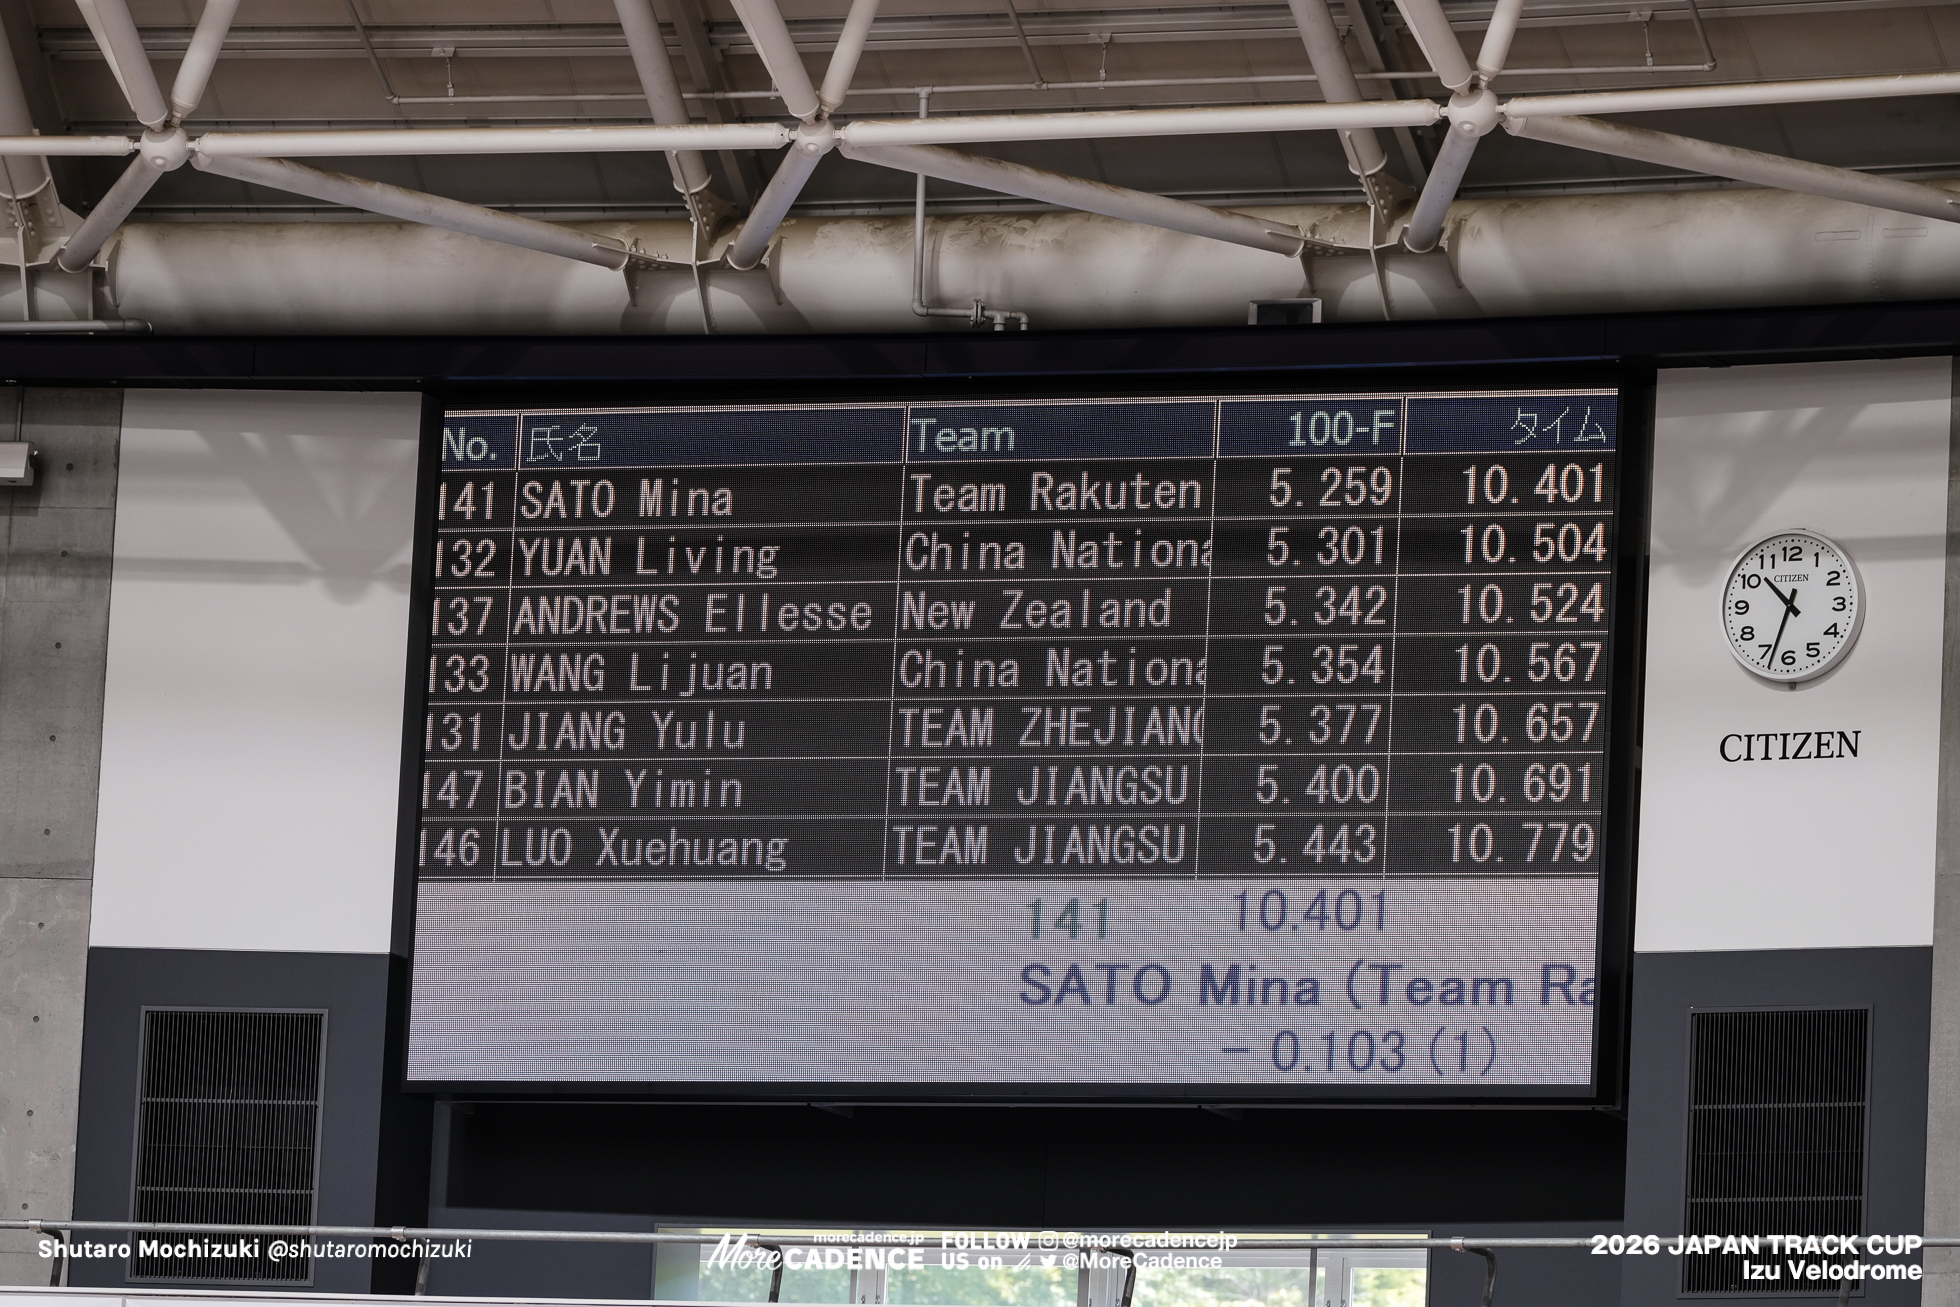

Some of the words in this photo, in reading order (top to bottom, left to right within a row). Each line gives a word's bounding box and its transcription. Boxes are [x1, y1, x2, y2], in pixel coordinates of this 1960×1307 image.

[442, 427, 497, 461] No.
[525, 422, 602, 463] 氏名
[909, 417, 1016, 453] Team
[1288, 409, 1396, 447] 100-F
[1510, 405, 1608, 446] タイム
[438, 481, 494, 521] 141
[520, 479, 616, 520] SATO
[638, 478, 733, 518] Mina
[910, 473, 1006, 513] Team
[1030, 471, 1202, 511] Rakuten
[434, 538, 497, 578] 132
[518, 536, 612, 577] YUAN
[635, 534, 780, 580] Living
[905, 531, 1026, 572] China
[1759, 553, 1776, 569] 11
[1782, 545, 1803, 562] 12
[1813, 551, 1820, 568] 1
[1740, 573, 1761, 590] 10
[1773, 574, 1809, 583] CITIZEN
[1825, 570, 1841, 586] 2
[431, 596, 494, 636] 137
[513, 594, 680, 635] ANDREWS
[704, 592, 873, 633] Ellesse
[901, 590, 976, 630] New
[999, 587, 1172, 630] Zealand
[1734, 600, 1750, 615] 9
[1832, 596, 1847, 612] 3
[1740, 625, 1755, 641] 8
[1805, 642, 1821, 658] 5
[1823, 622, 1840, 638] 4
[899, 648, 1020, 689] China
[1758, 644, 1773, 660] 7
[1781, 650, 1796, 666] 6
[428, 653, 490, 694] 133
[511, 652, 605, 692] WANG
[629, 651, 773, 698] Lijuan
[425, 712, 481, 752] 131
[508, 710, 626, 751] JIANG
[651, 709, 746, 750] Yulu
[898, 707, 994, 748] TEAM
[1719, 731, 1862, 762] CITIZEN
[422, 769, 484, 809] 147
[504, 769, 599, 809] BIAN
[624, 768, 743, 808] Yimin
[895, 766, 991, 807] TEAM
[1016, 765, 1189, 806] JIANGSU
[418, 827, 480, 867] 146
[500, 827, 573, 867] LUO
[595, 827, 789, 873] Xuehuang
[892, 825, 989, 865] TEAM
[1014, 824, 1186, 865] JIANGSU
[1027, 897, 1109, 940] 141
[1233, 887, 1386, 933] 10.401
[1018, 962, 1173, 1007] SATO
[1198, 963, 1320, 1007] Mina
[1345, 958, 1515, 1011] (Team
[1270, 1028, 1407, 1074] 0.103
[1429, 1025, 1498, 1078] (1)
